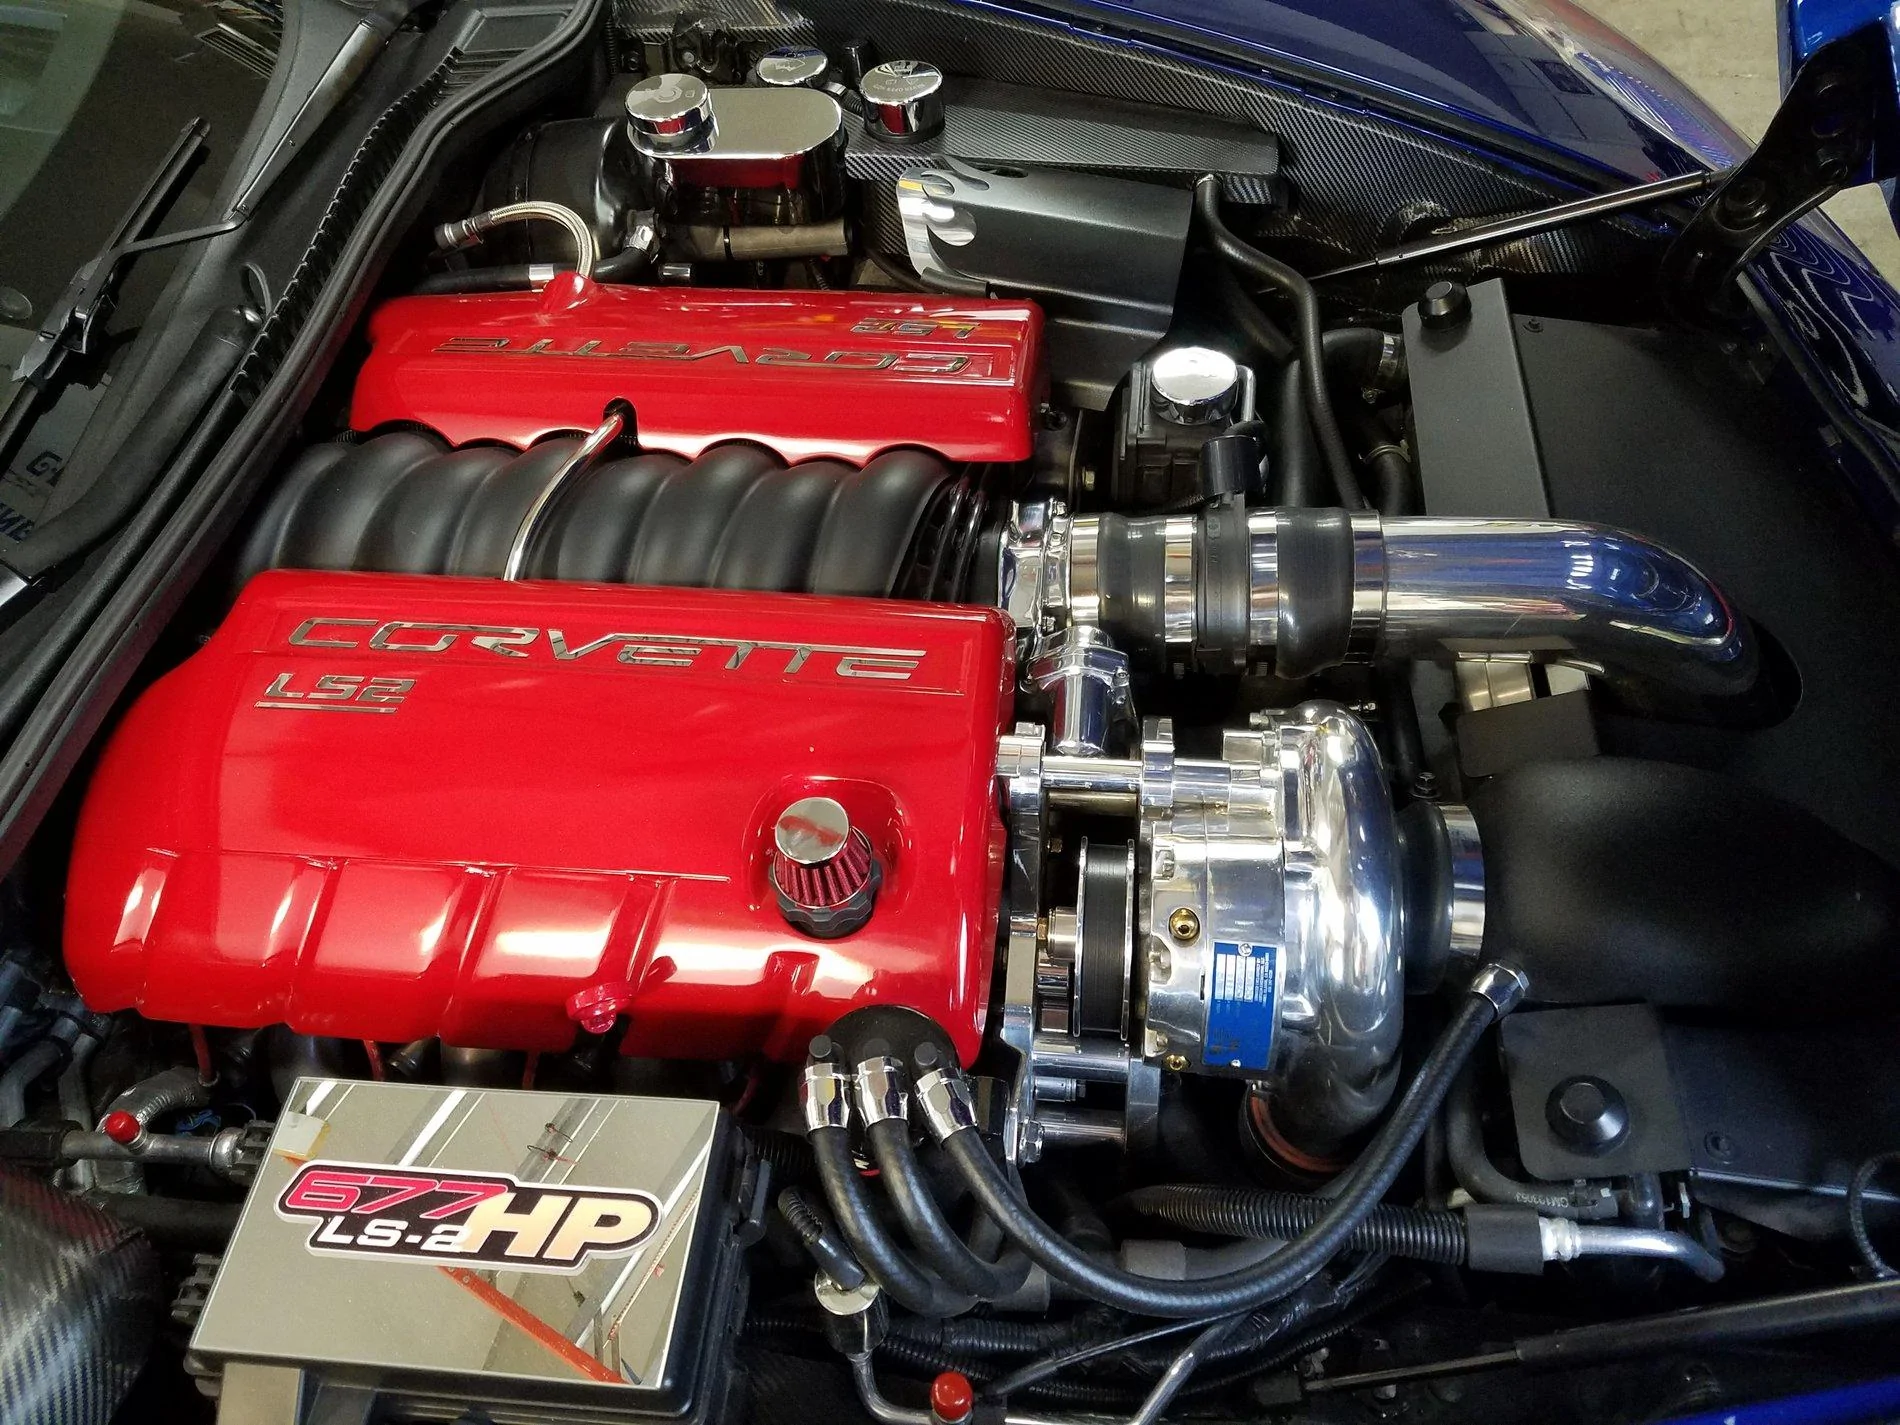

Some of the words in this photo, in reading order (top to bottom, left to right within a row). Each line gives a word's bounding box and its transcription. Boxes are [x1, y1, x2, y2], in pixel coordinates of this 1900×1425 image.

[850, 317, 983, 339] LS2
[431, 336, 971, 374] CORVETTE
[288, 616, 927, 680] CORVETTE
[264, 672, 417, 704] LS2
[285, 1169, 509, 1220] 677
[460, 1191, 653, 1261] HP
[316, 1215, 472, 1253] LS-2
